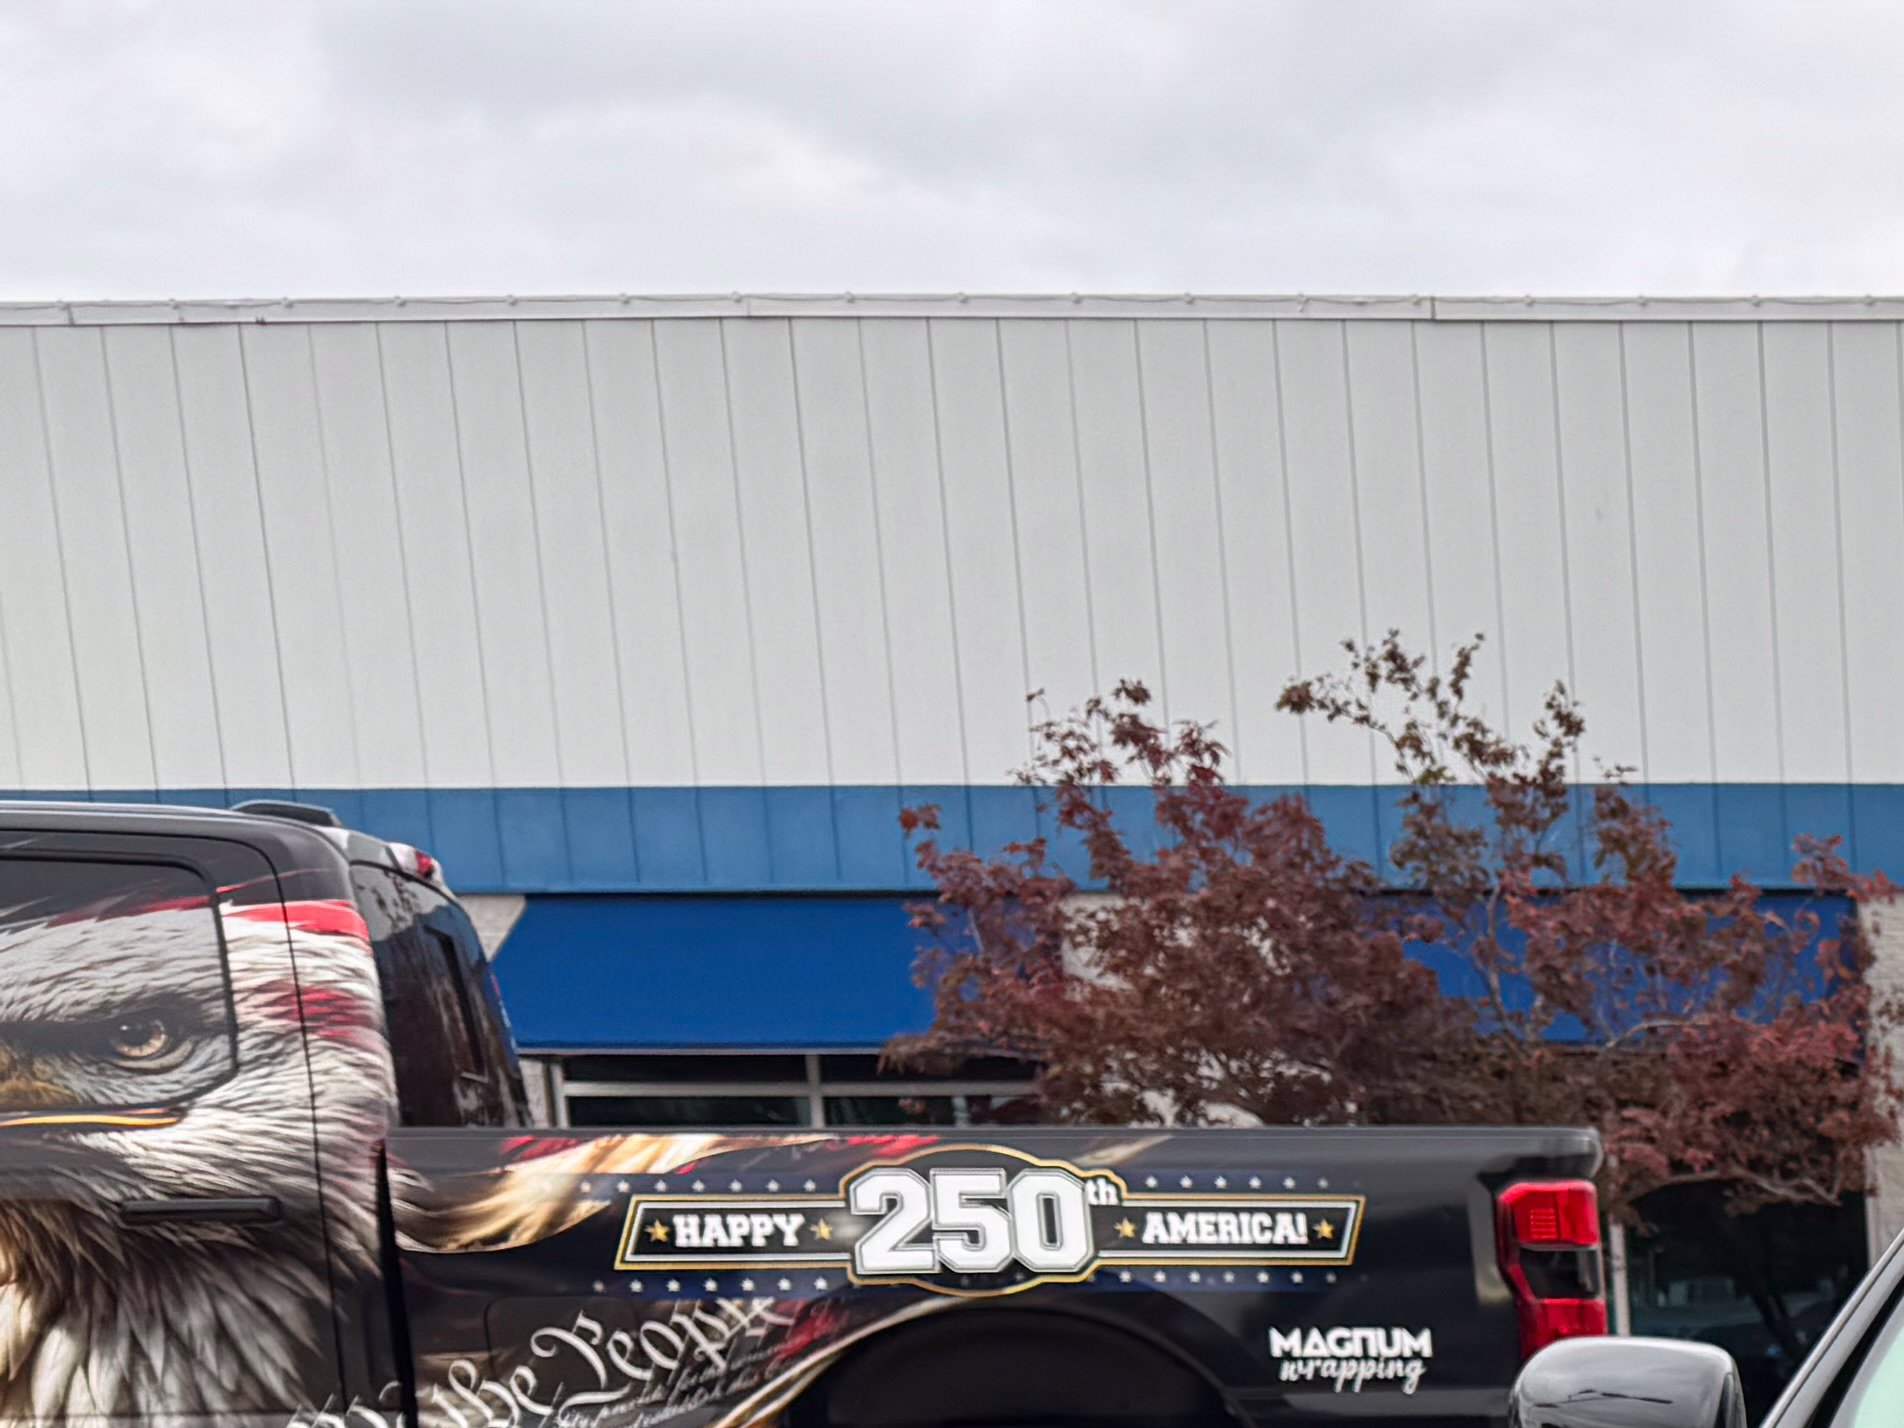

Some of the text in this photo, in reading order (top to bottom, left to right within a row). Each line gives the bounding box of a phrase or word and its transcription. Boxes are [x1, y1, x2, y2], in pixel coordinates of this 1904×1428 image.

[673, 1213, 805, 1248] HAPPY
[1141, 1211, 1309, 1246] AMERICA!
[1268, 1325, 1433, 1359] MAGNUM
[1279, 1356, 1427, 1396] wrapping
